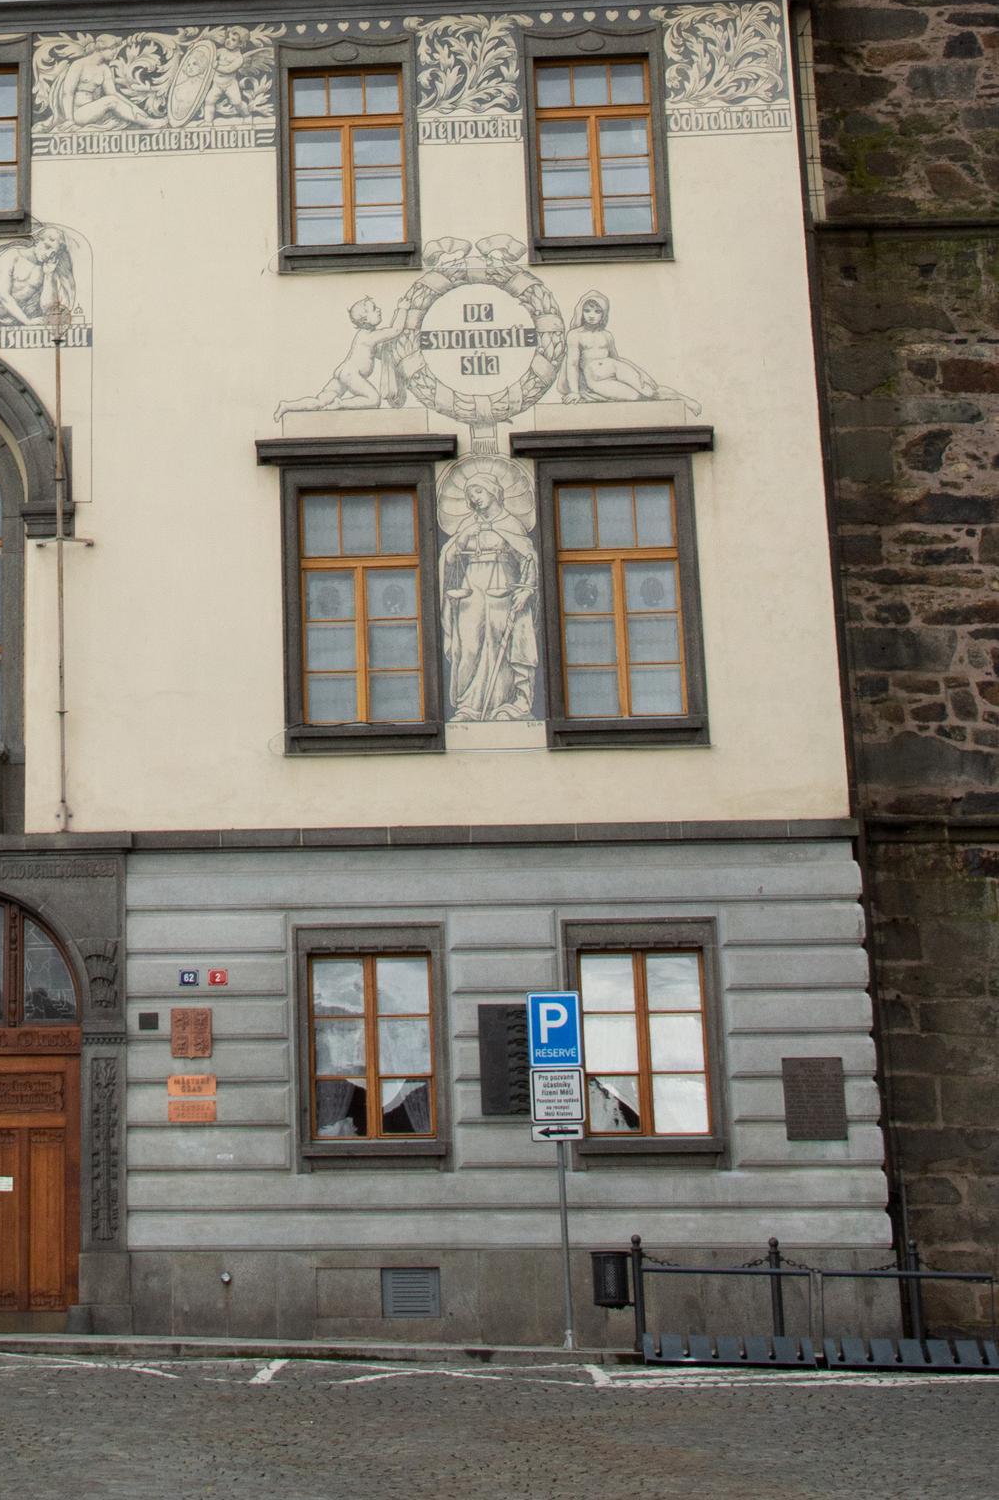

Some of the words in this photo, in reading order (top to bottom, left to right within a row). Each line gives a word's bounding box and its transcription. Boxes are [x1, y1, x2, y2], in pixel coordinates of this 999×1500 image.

[183, 973, 195, 983] 62
[214, 973, 221, 983] 2
[538, 1002, 569, 1044] P
[535, 1046, 577, 1058] RÉSERVÉ
